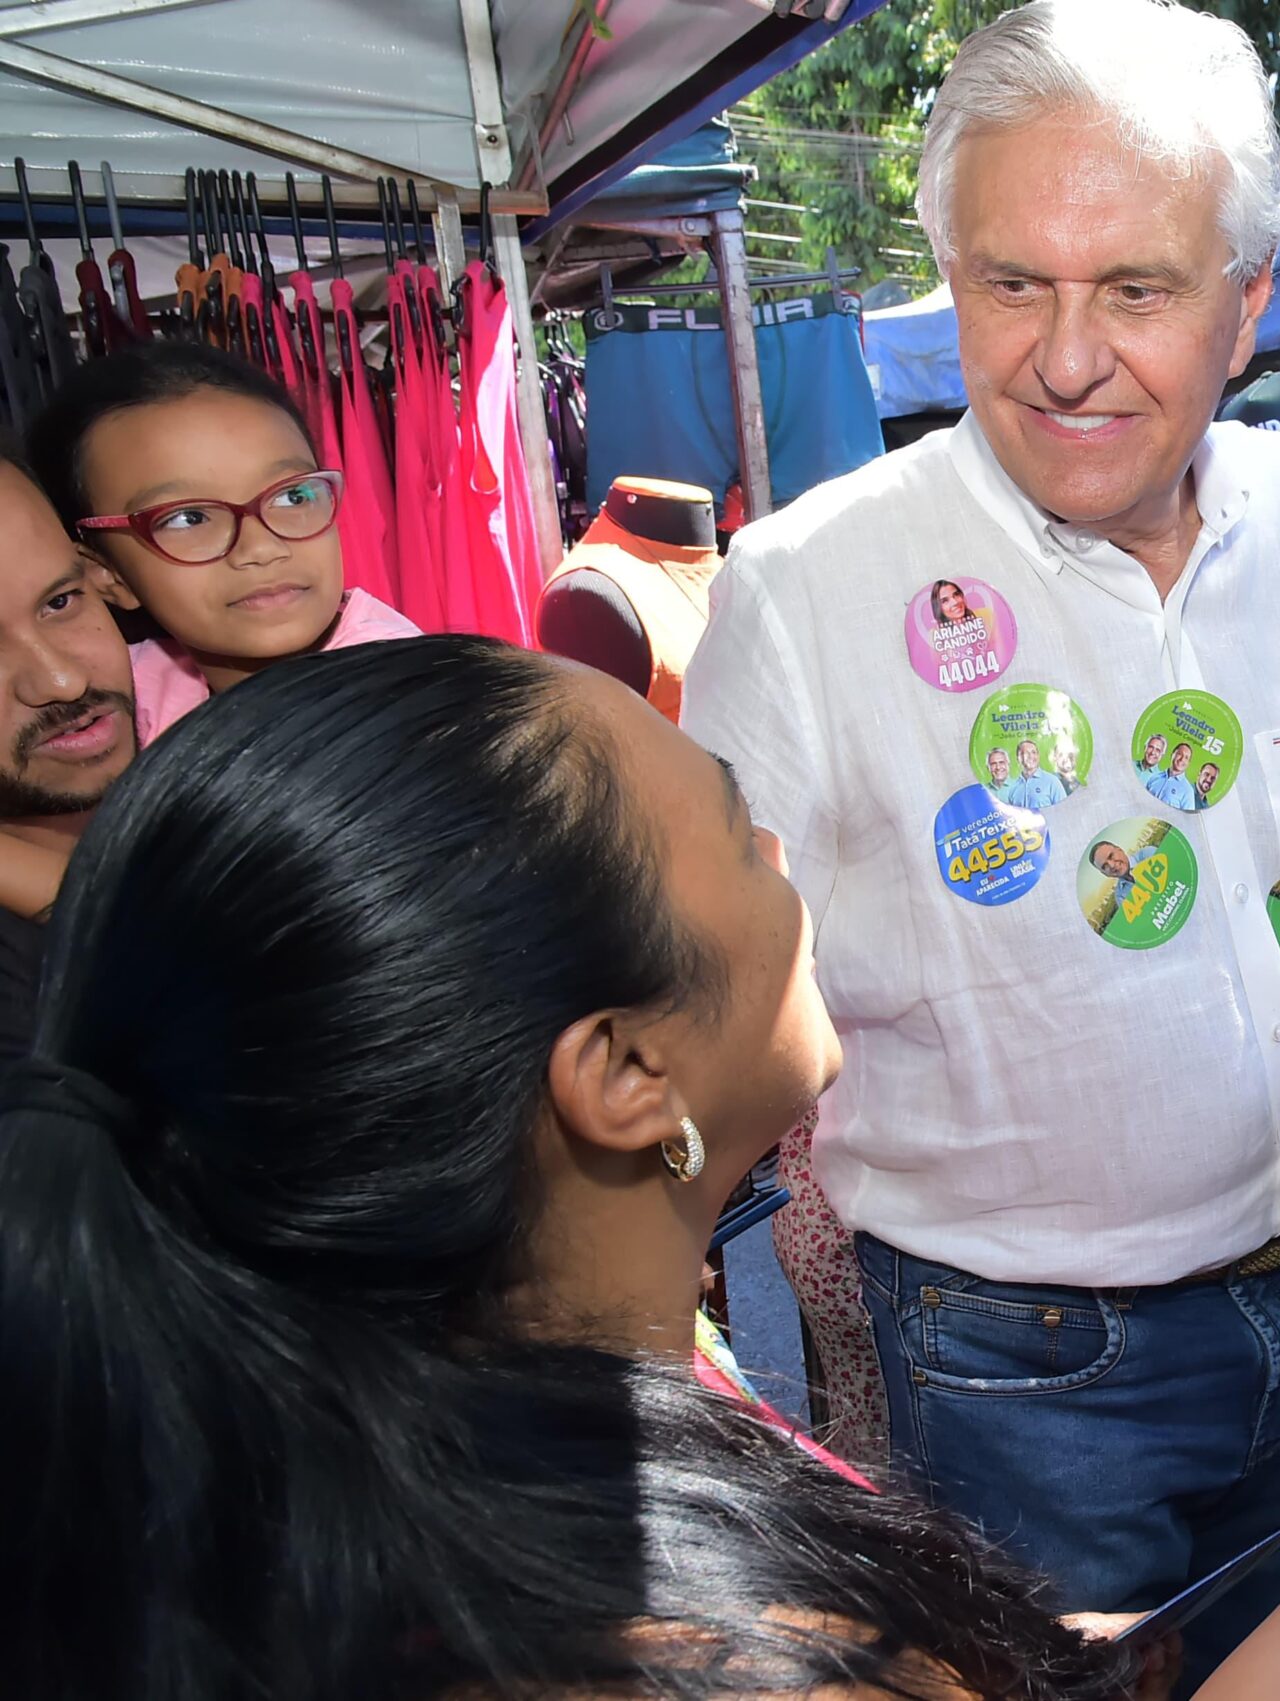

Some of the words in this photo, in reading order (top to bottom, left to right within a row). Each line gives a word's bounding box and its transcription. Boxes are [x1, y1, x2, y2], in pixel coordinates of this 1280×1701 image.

[933, 617, 984, 642] ARIANNE
[935, 629, 987, 652] CANDIDO
[939, 650, 1000, 688] 44044
[991, 710, 1045, 723] Leandro
[1000, 721, 1039, 732] Vilela
[1171, 705, 1216, 735] Leandro
[1175, 717, 1206, 741] Vilela
[1202, 735, 1225, 756] 15
[952, 831, 980, 851] Tatá
[948, 829, 1043, 884] 44555
[1122, 885, 1151, 925] 44
[1152, 880, 1186, 930] Mabel
